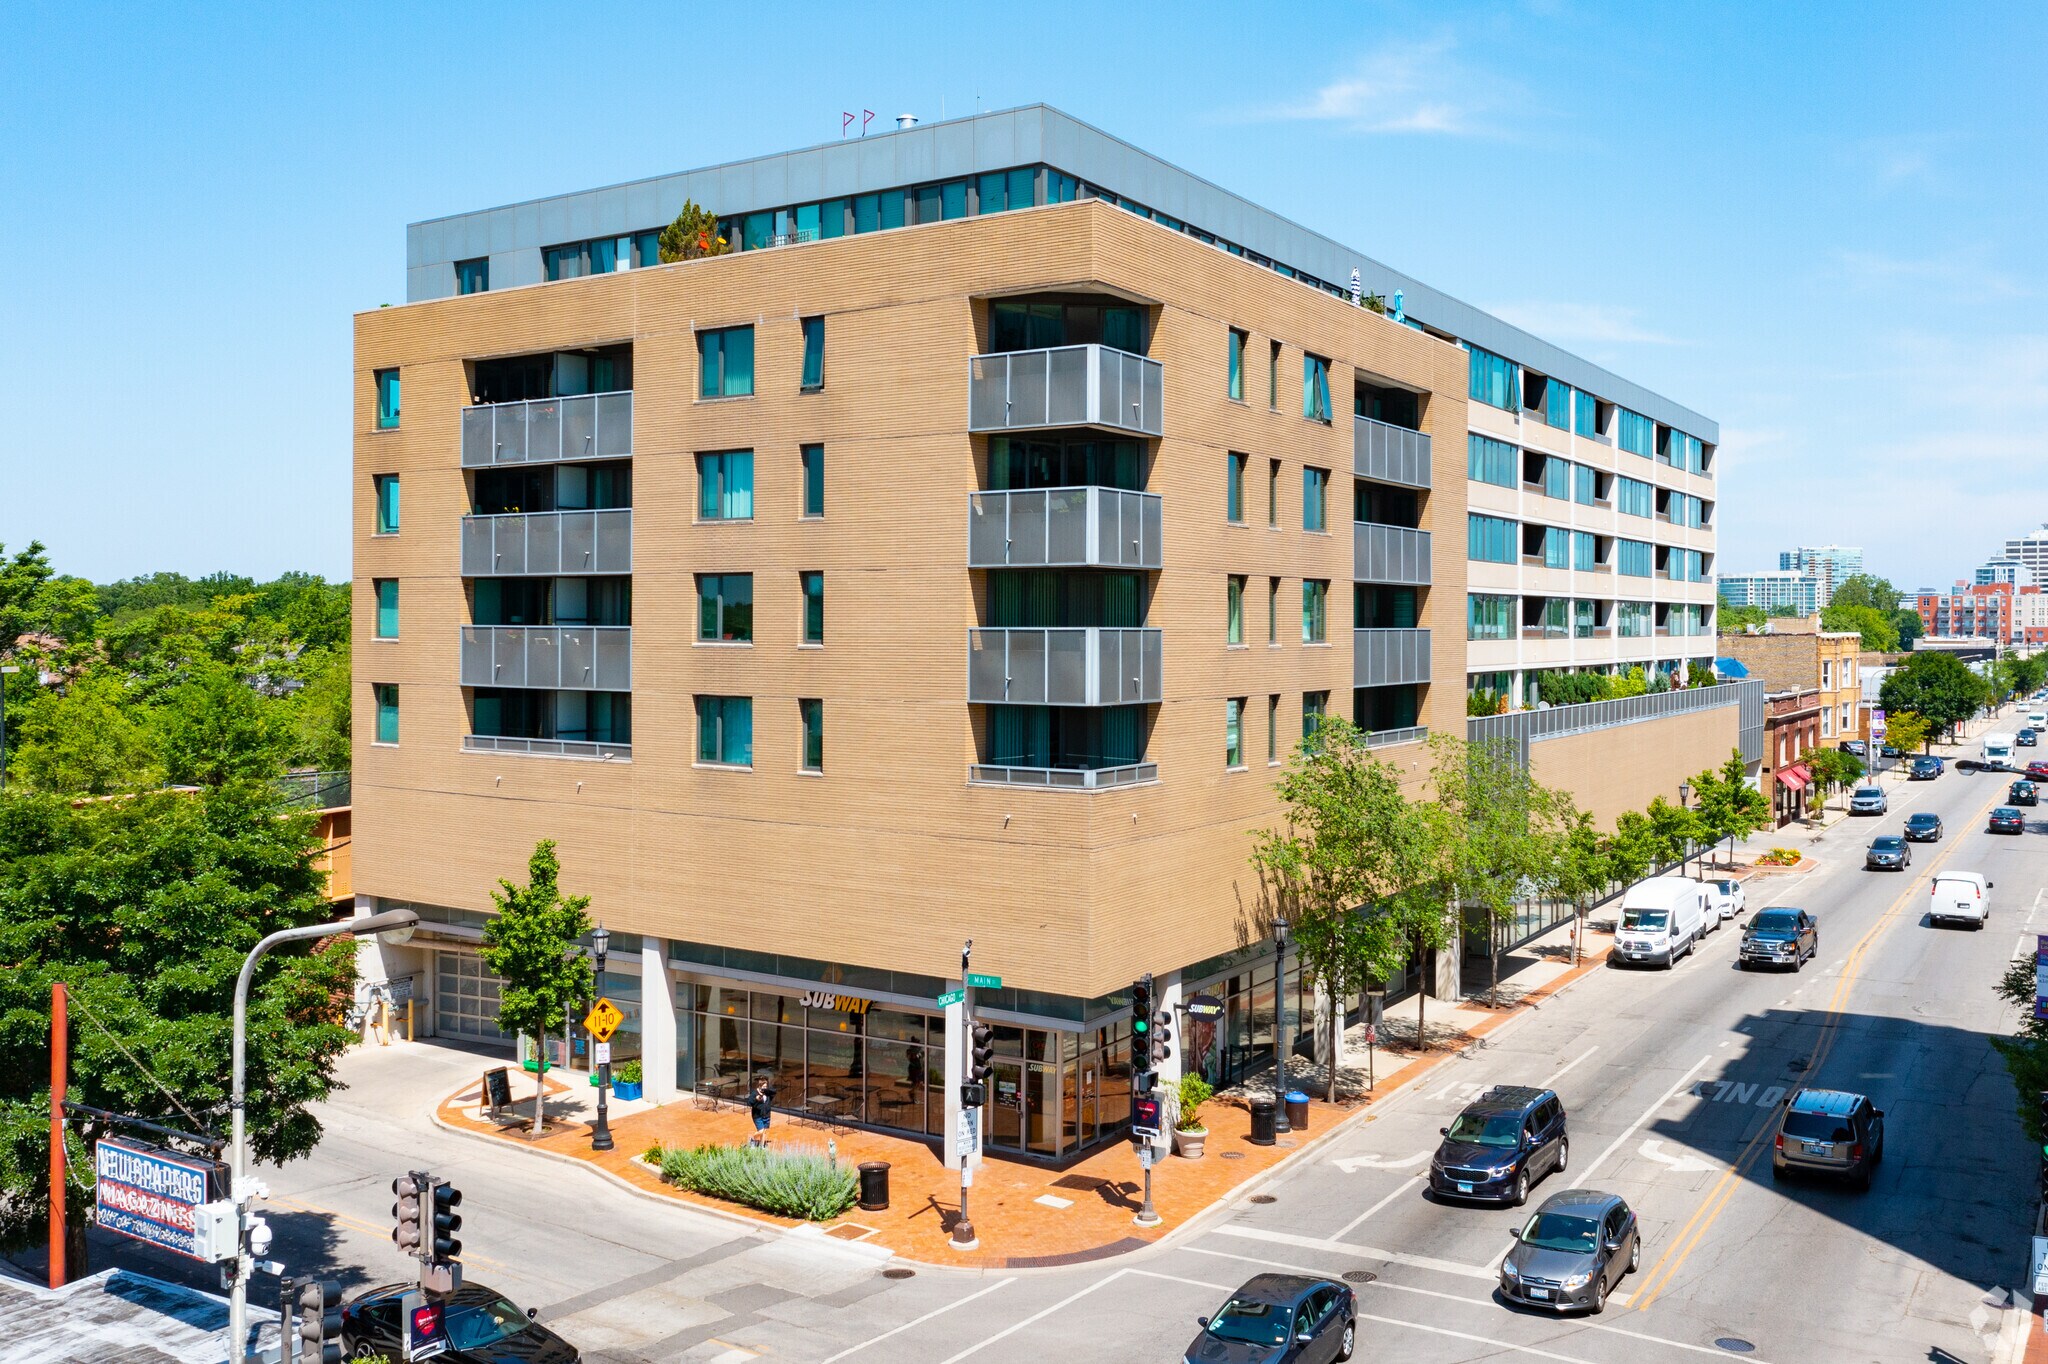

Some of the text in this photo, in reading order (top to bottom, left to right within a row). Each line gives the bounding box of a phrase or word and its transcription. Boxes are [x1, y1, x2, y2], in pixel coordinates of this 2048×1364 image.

[974, 976, 991, 985] MAIN
[799, 990, 873, 1014] SUBWAY
[1188, 1004, 1221, 1015] SUBWAY
[1028, 1064, 1057, 1075] SUBWAY
[1673, 1079, 1787, 1108] ONLY
[99, 1148, 202, 1204] NEWSPAPERS
[99, 1182, 196, 1229] MAGAZINES
